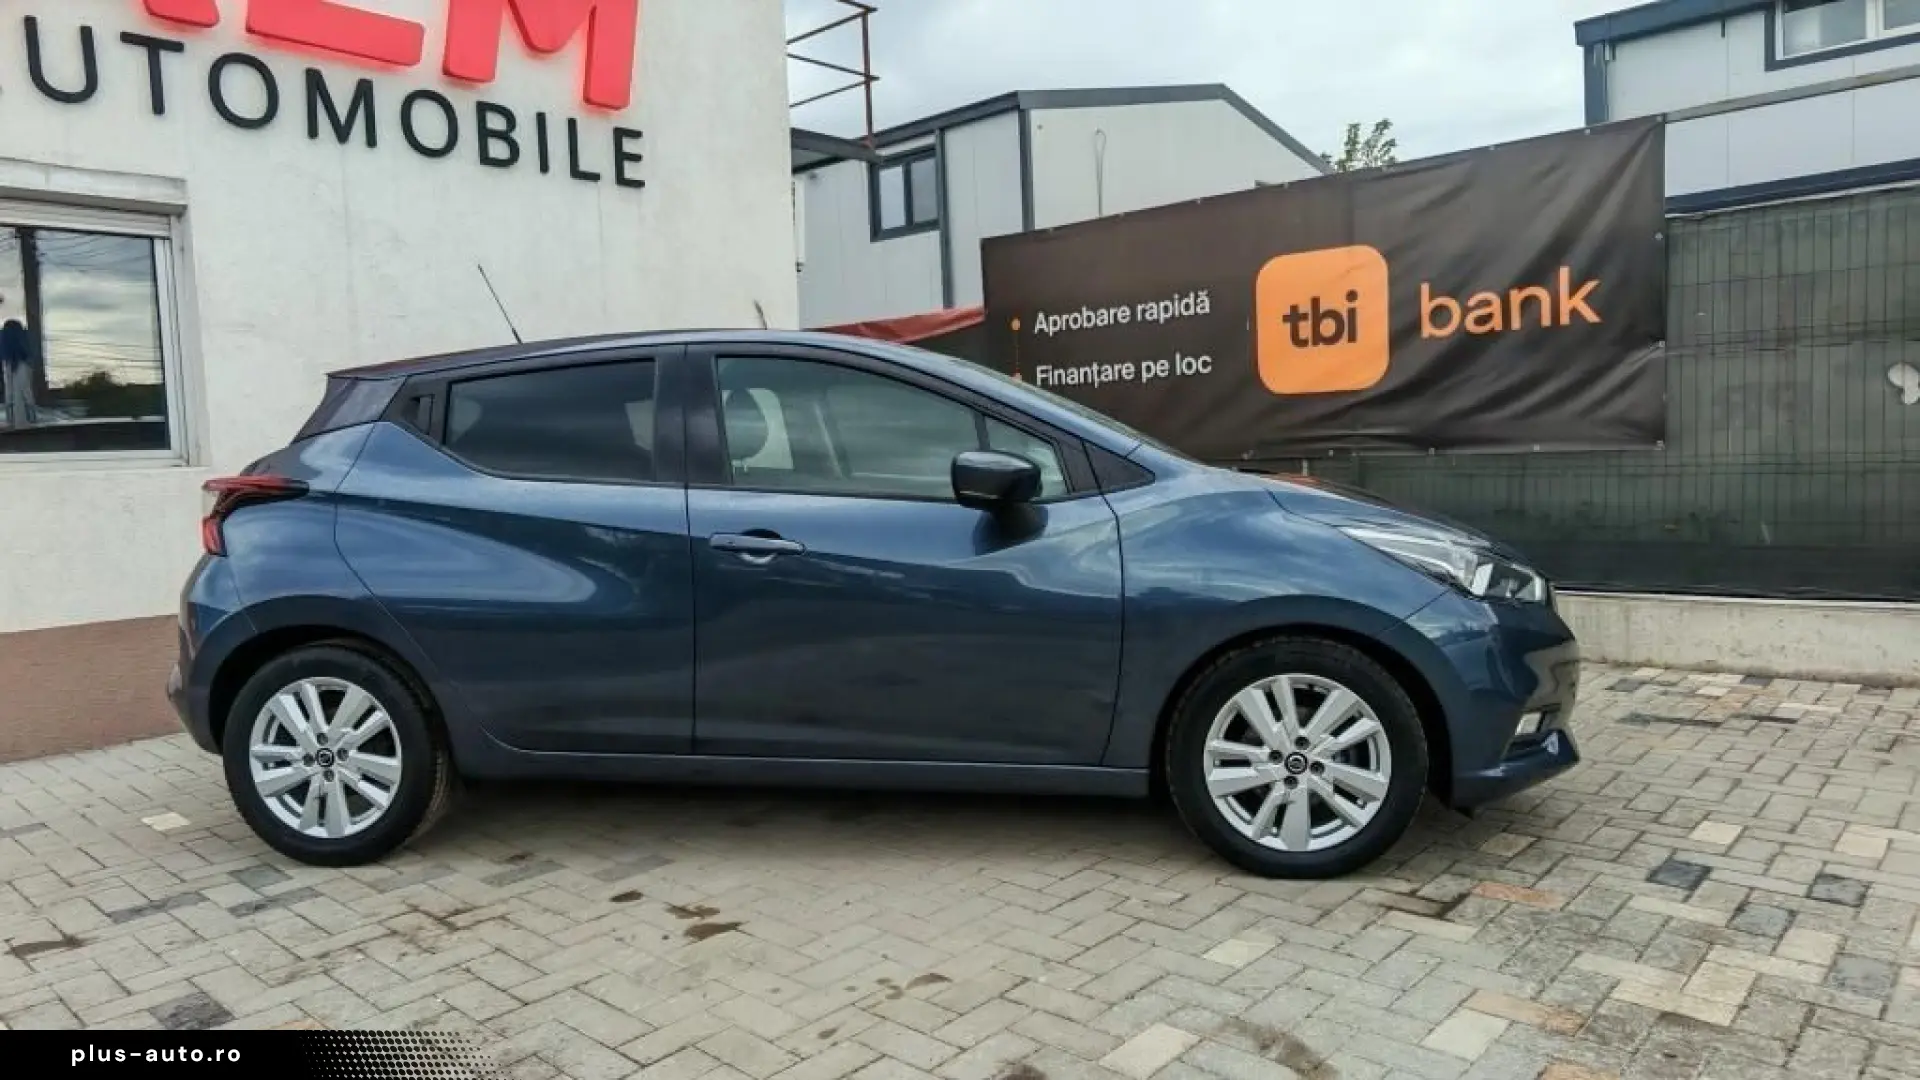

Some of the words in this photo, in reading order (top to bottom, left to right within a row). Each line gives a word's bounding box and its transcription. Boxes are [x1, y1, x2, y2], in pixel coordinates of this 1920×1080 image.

[0, 14, 646, 188] UTOMOBILE
[1034, 305, 1131, 337] Aprobare
[1136, 289, 1211, 324] rapidă
[1282, 288, 1358, 348] tbi
[1419, 265, 1601, 340] bank
[1036, 361, 1136, 388] Finanțare
[1141, 358, 1170, 384] pe
[1174, 351, 1213, 376] loc
